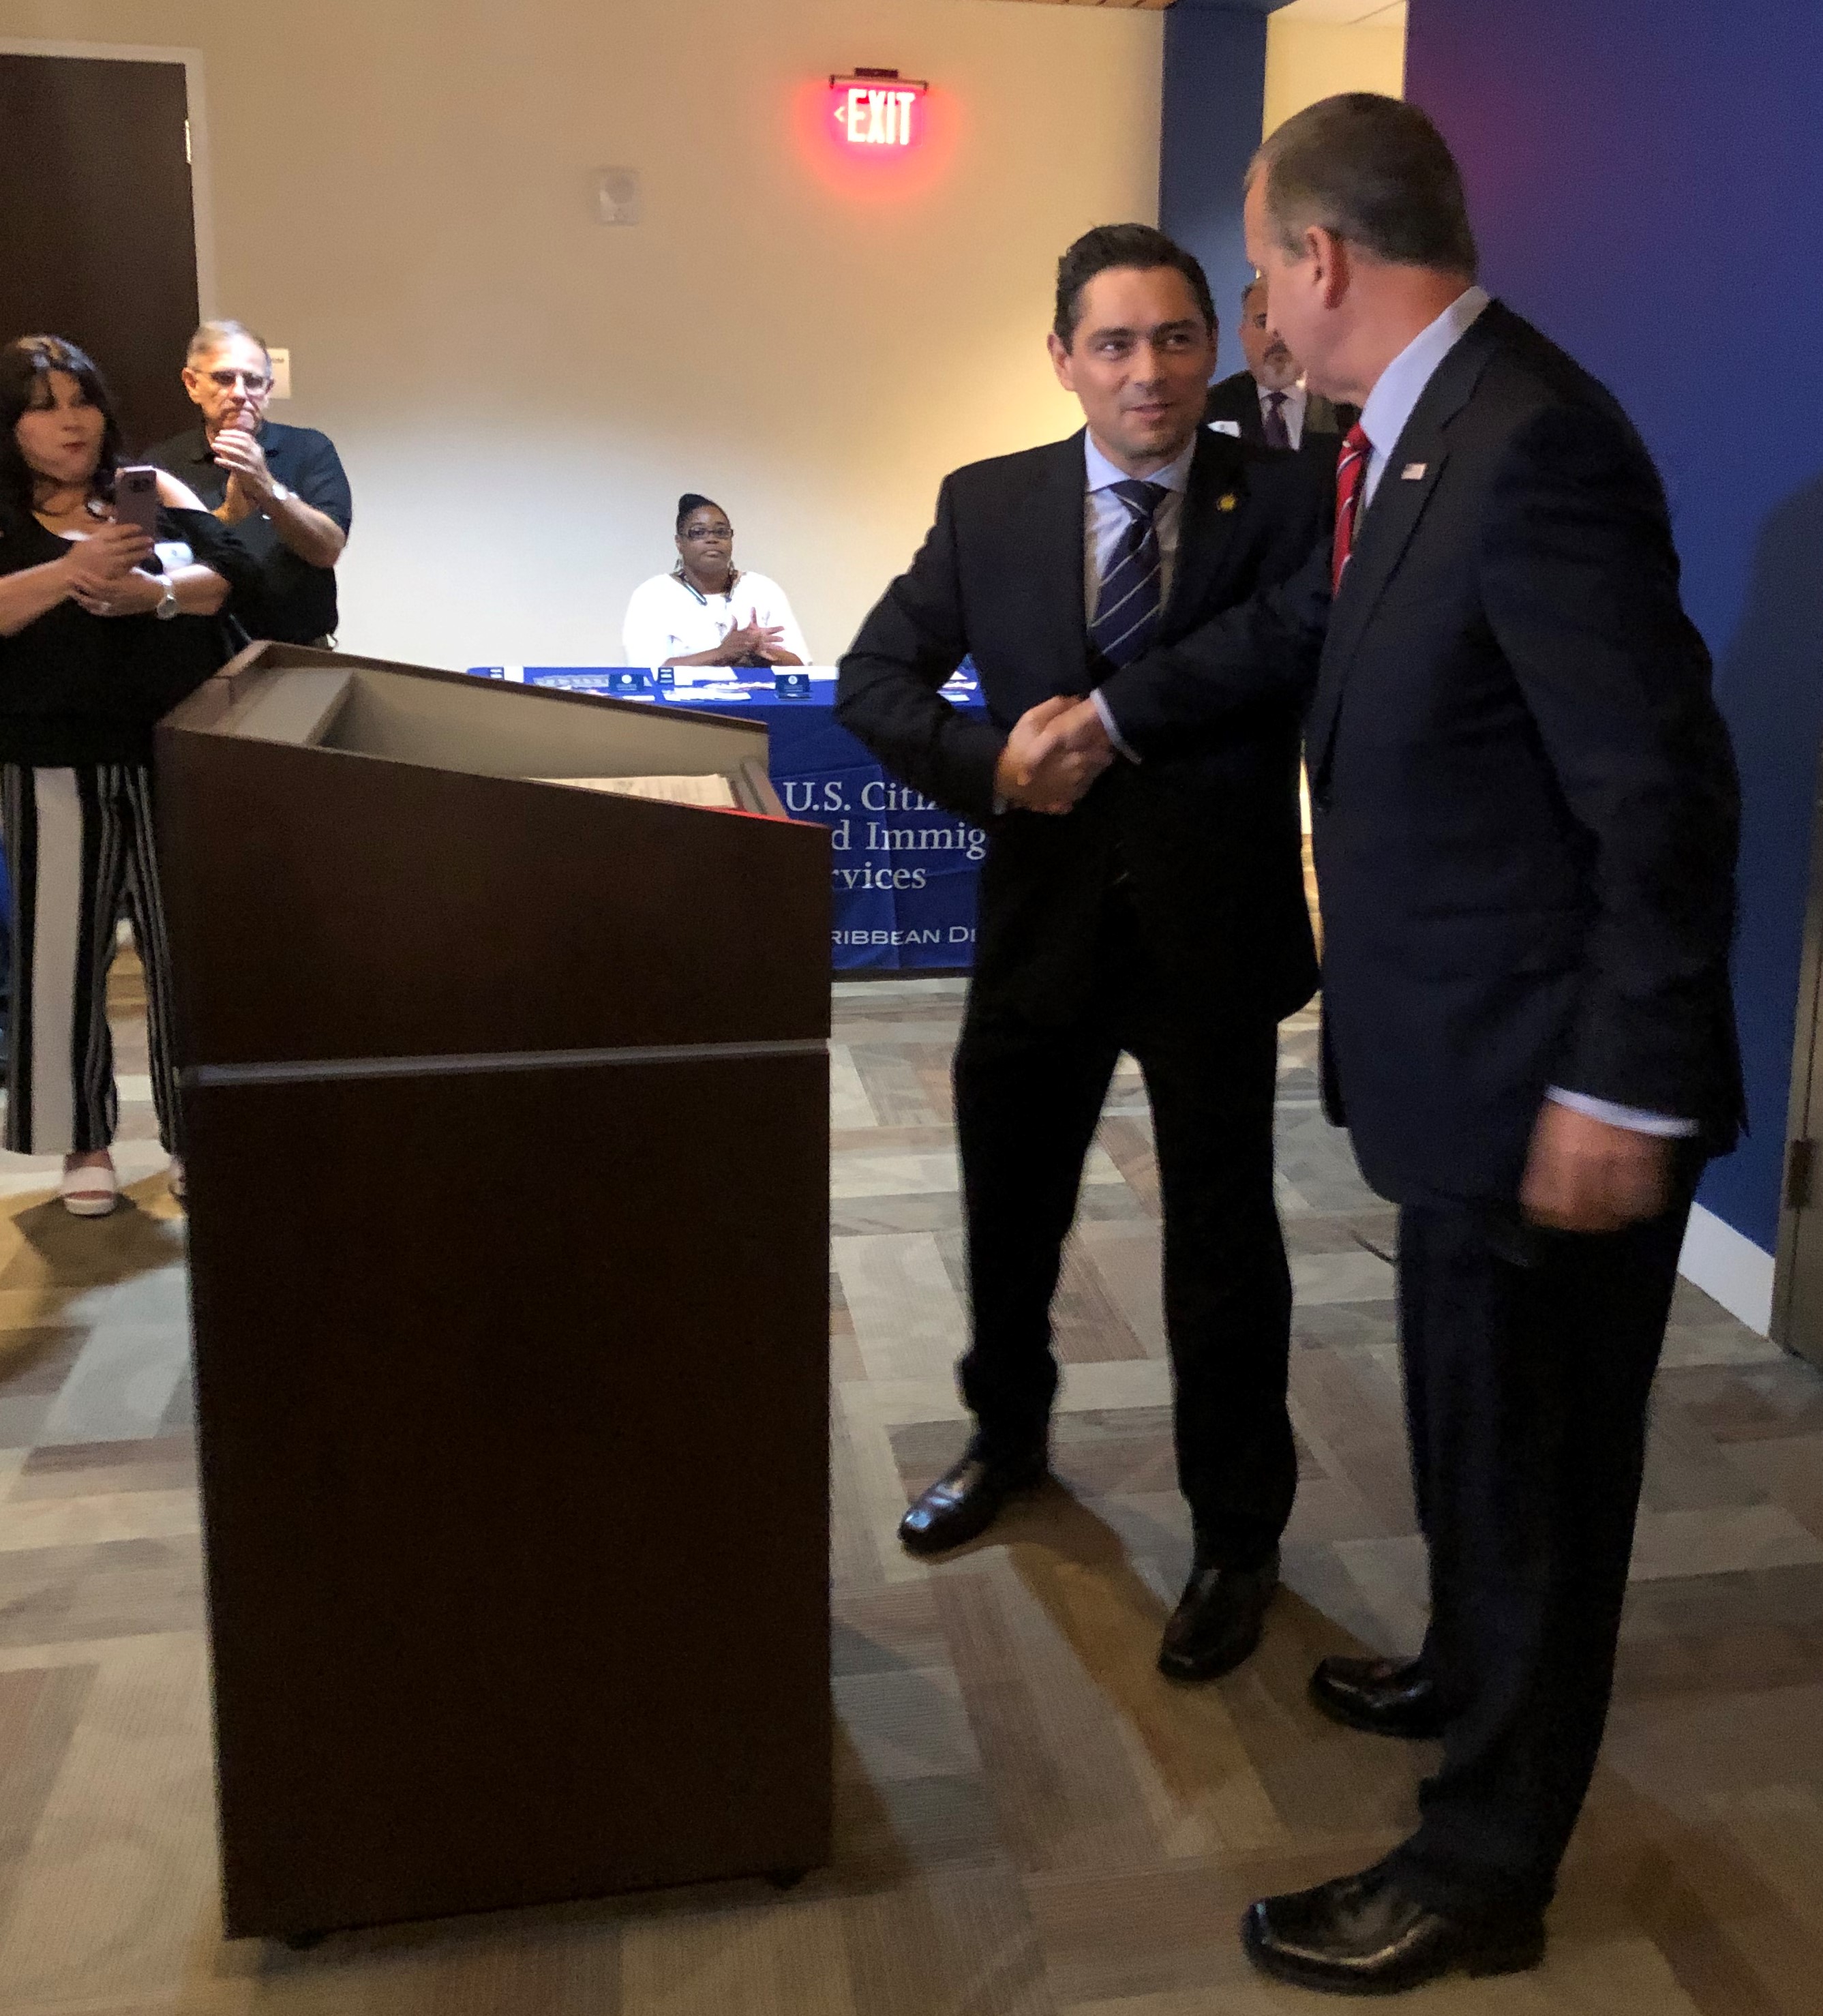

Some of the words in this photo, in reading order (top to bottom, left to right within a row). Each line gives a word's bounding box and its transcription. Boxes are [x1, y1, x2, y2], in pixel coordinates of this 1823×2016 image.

[847, 89, 916, 145] EXIT
[783, 782, 851, 811] U.S.
[831, 819, 852, 850] d
[866, 822, 986, 860] Immig
[831, 929, 940, 946] RIBBEAN
